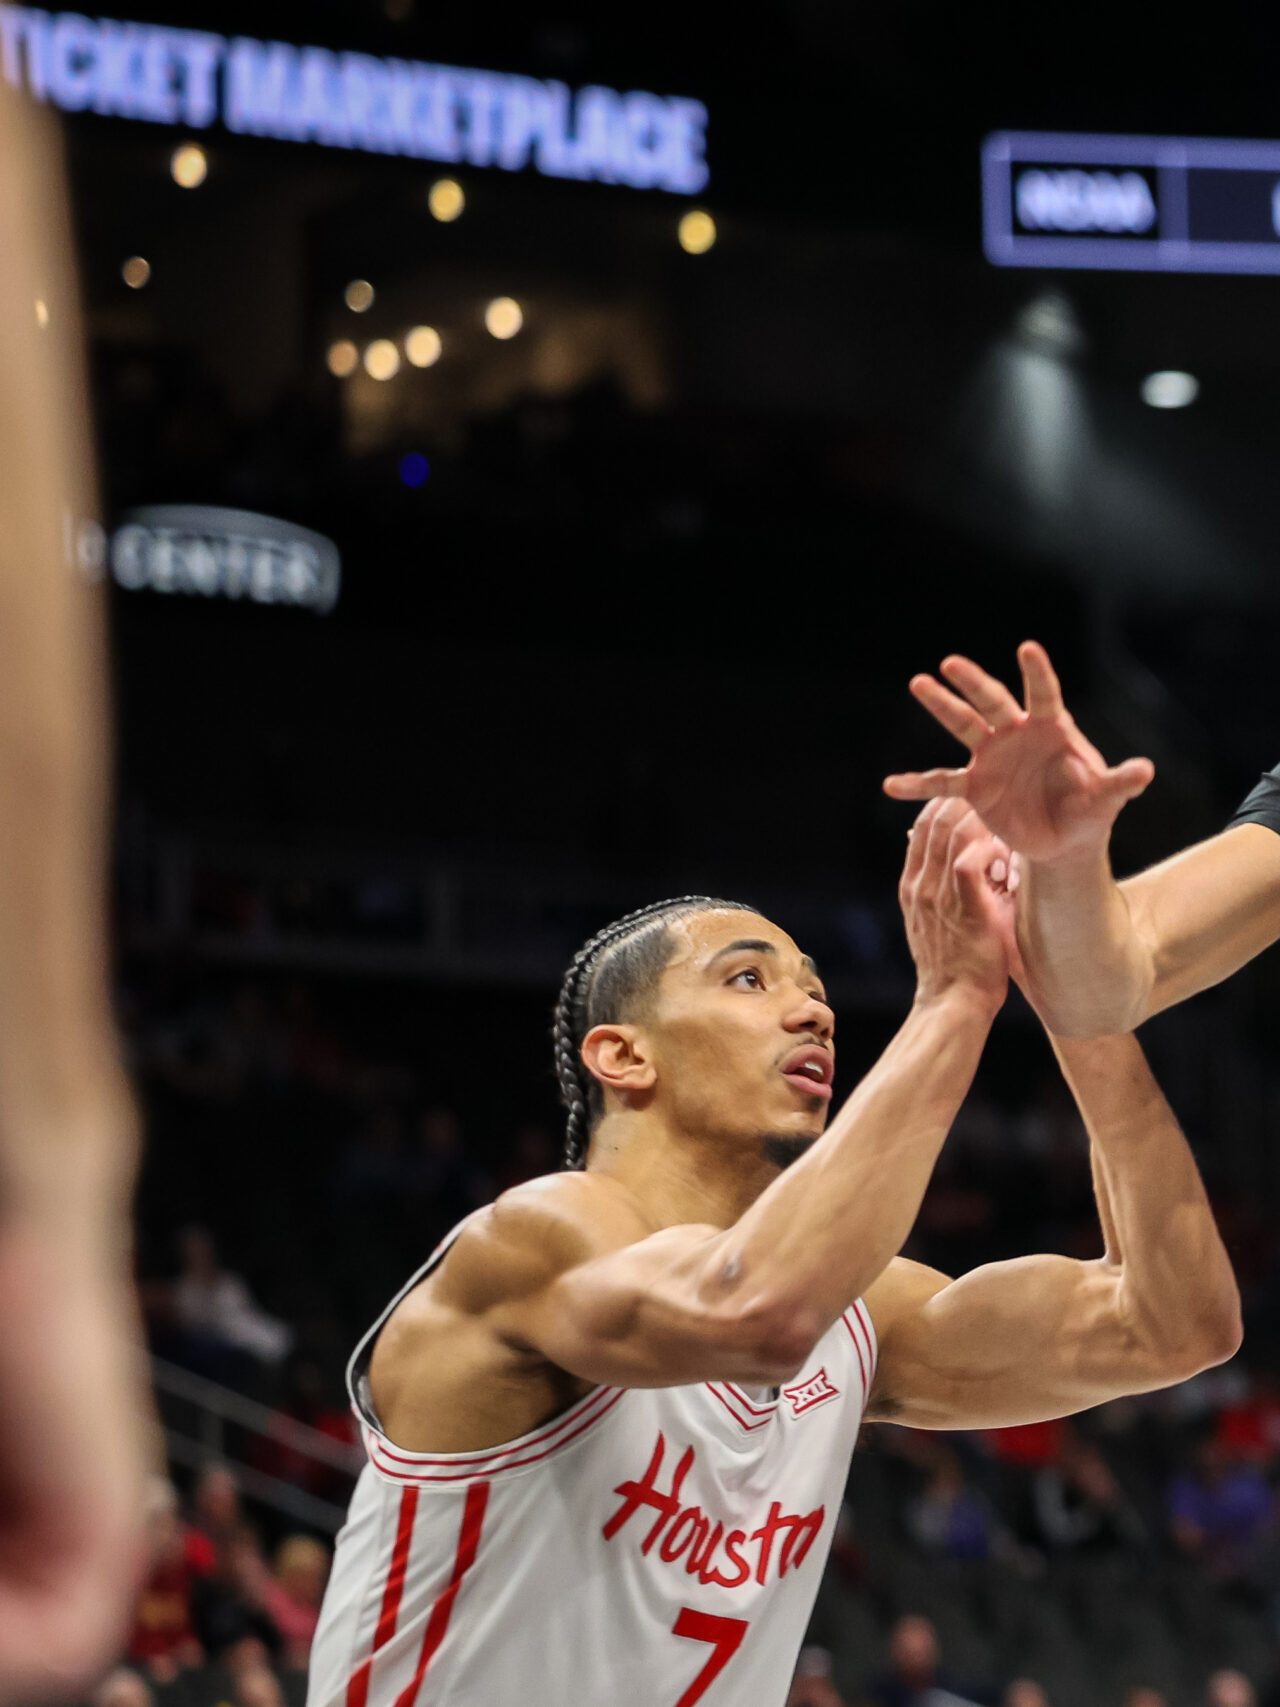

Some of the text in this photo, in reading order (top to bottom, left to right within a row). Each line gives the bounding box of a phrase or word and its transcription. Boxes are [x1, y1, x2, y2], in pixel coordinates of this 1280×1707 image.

[0, 4, 709, 195] TICKET MARKETPLACE
[1015, 170, 1156, 233] NCAA
[112, 524, 325, 606] CENTER
[602, 1430, 825, 1588] Houstn
[672, 1607, 750, 1707] 7
